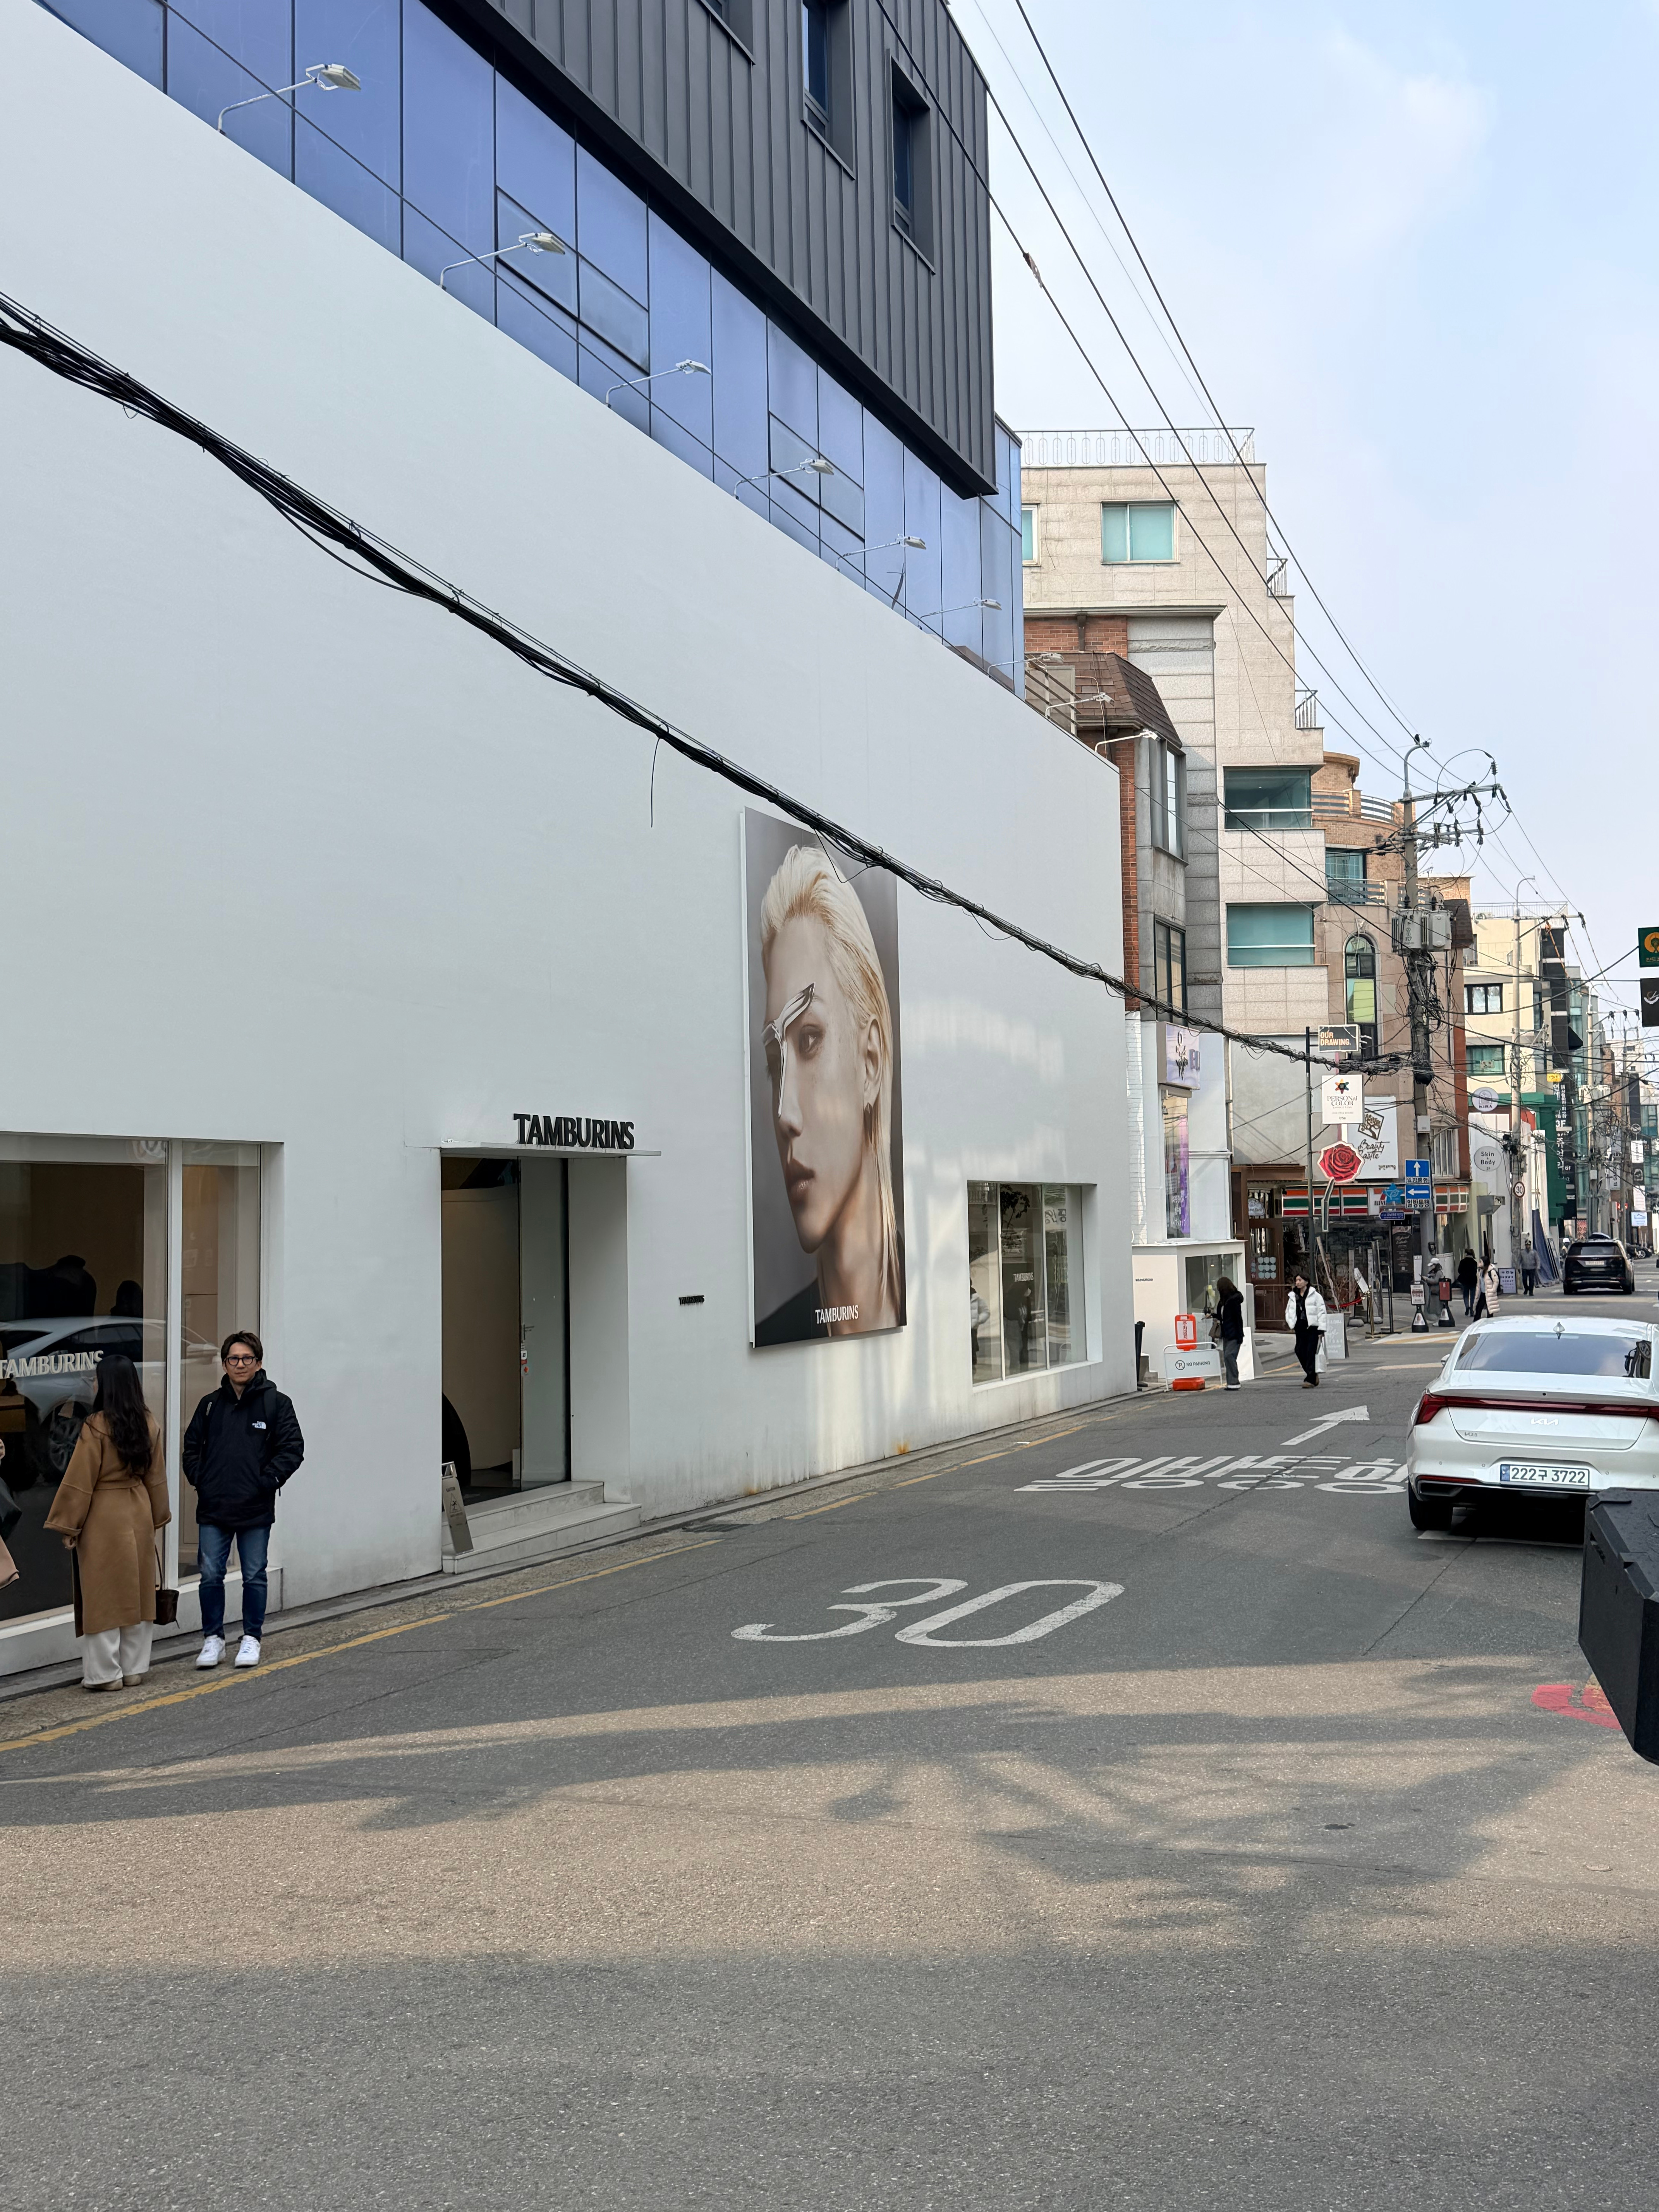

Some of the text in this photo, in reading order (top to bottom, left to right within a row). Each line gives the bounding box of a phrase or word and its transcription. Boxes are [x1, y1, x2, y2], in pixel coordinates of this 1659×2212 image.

[514, 1113, 634, 1149] TAMBURINS
[1358, 1139, 1390, 1154] Beauty
[1516, 1186, 1523, 1194] 30
[1013, 1272, 1034, 1282] TAMBURINS
[815, 1305, 859, 1324] TAMBURINS
[1014, 1455, 1410, 1494] 일방통행
[1511, 1467, 1586, 1484] 222구 3722
[731, 1578, 1125, 1647] 30
